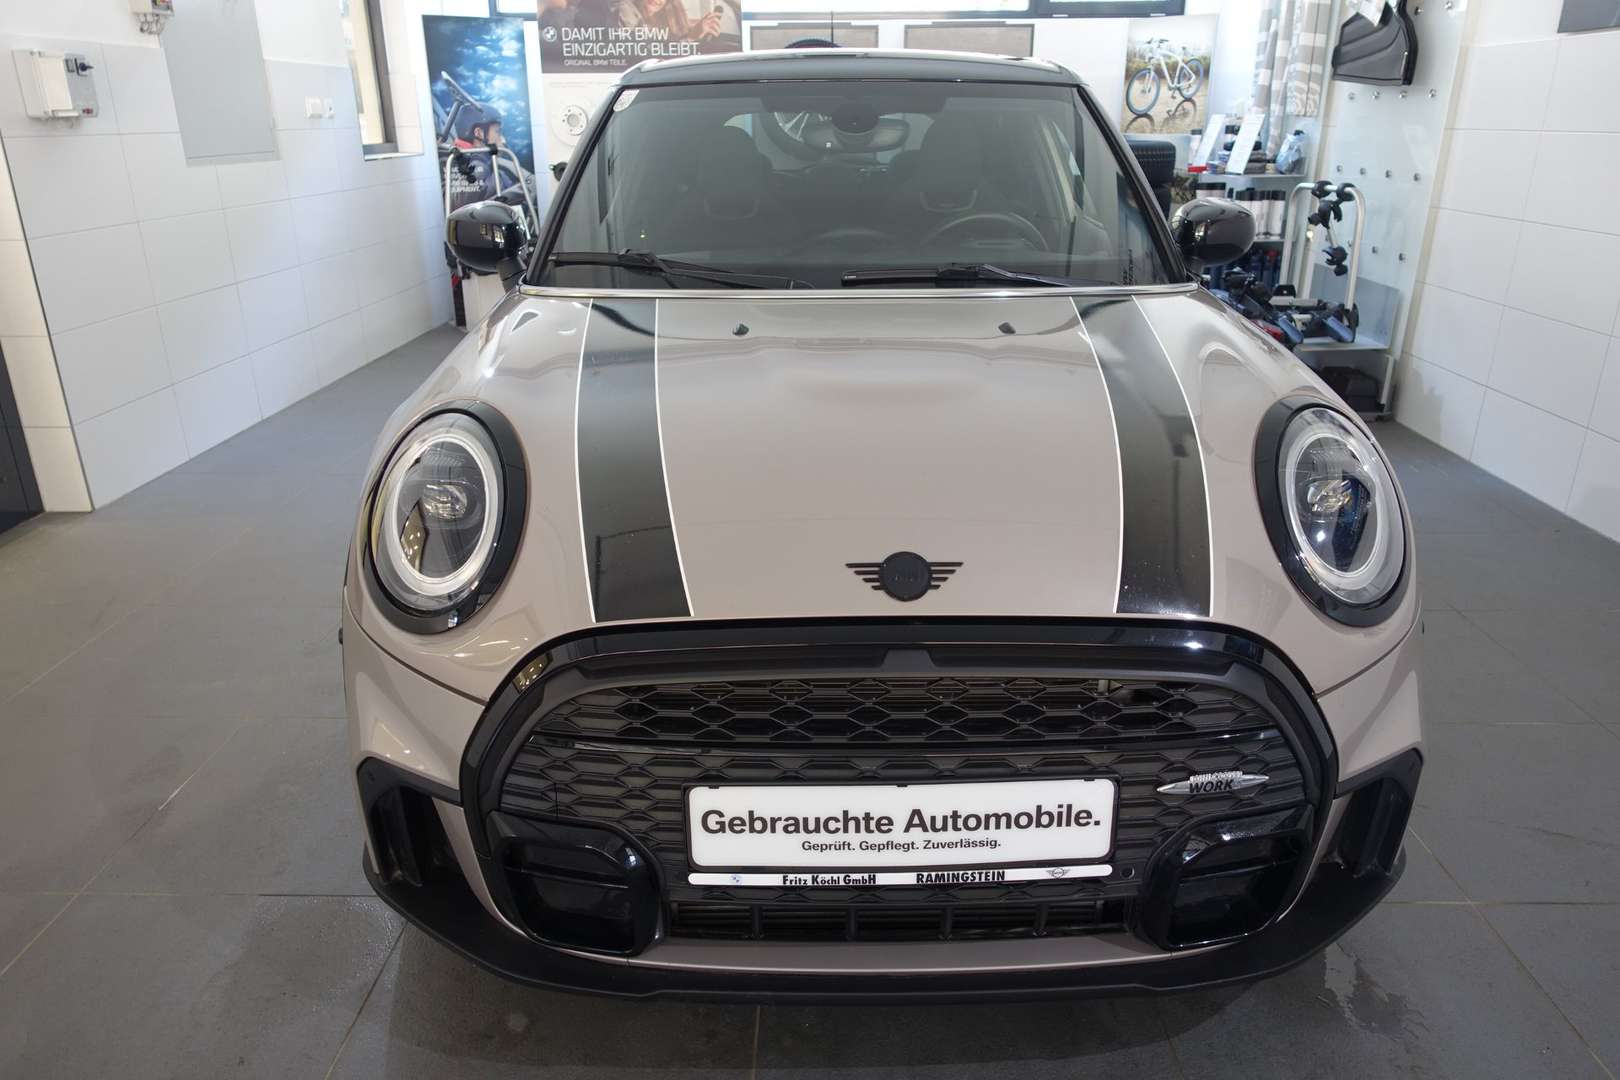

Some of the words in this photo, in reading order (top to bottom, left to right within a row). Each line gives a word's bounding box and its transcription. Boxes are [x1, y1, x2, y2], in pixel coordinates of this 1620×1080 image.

[561, 27, 605, 41] DAMIT
[608, 27, 633, 41] IHR
[635, 27, 669, 41] BMW
[563, 42, 647, 57] EINZIGARTIG
[651, 41, 701, 56] BLEIBT.
[1189, 779, 1233, 794] WORK
[701, 809, 894, 834] Gebrauchte
[903, 803, 1101, 833] Automobile.
[801, 840, 856, 853] Geprüft.
[859, 839, 919, 853] Gepflegt.
[923, 837, 1001, 850] Zuverlässig.
[782, 875, 808, 885] Fritz
[811, 874, 840, 885] Köchl
[843, 874, 877, 885] GmbH
[916, 870, 1006, 884] RAMINGSTEIN
